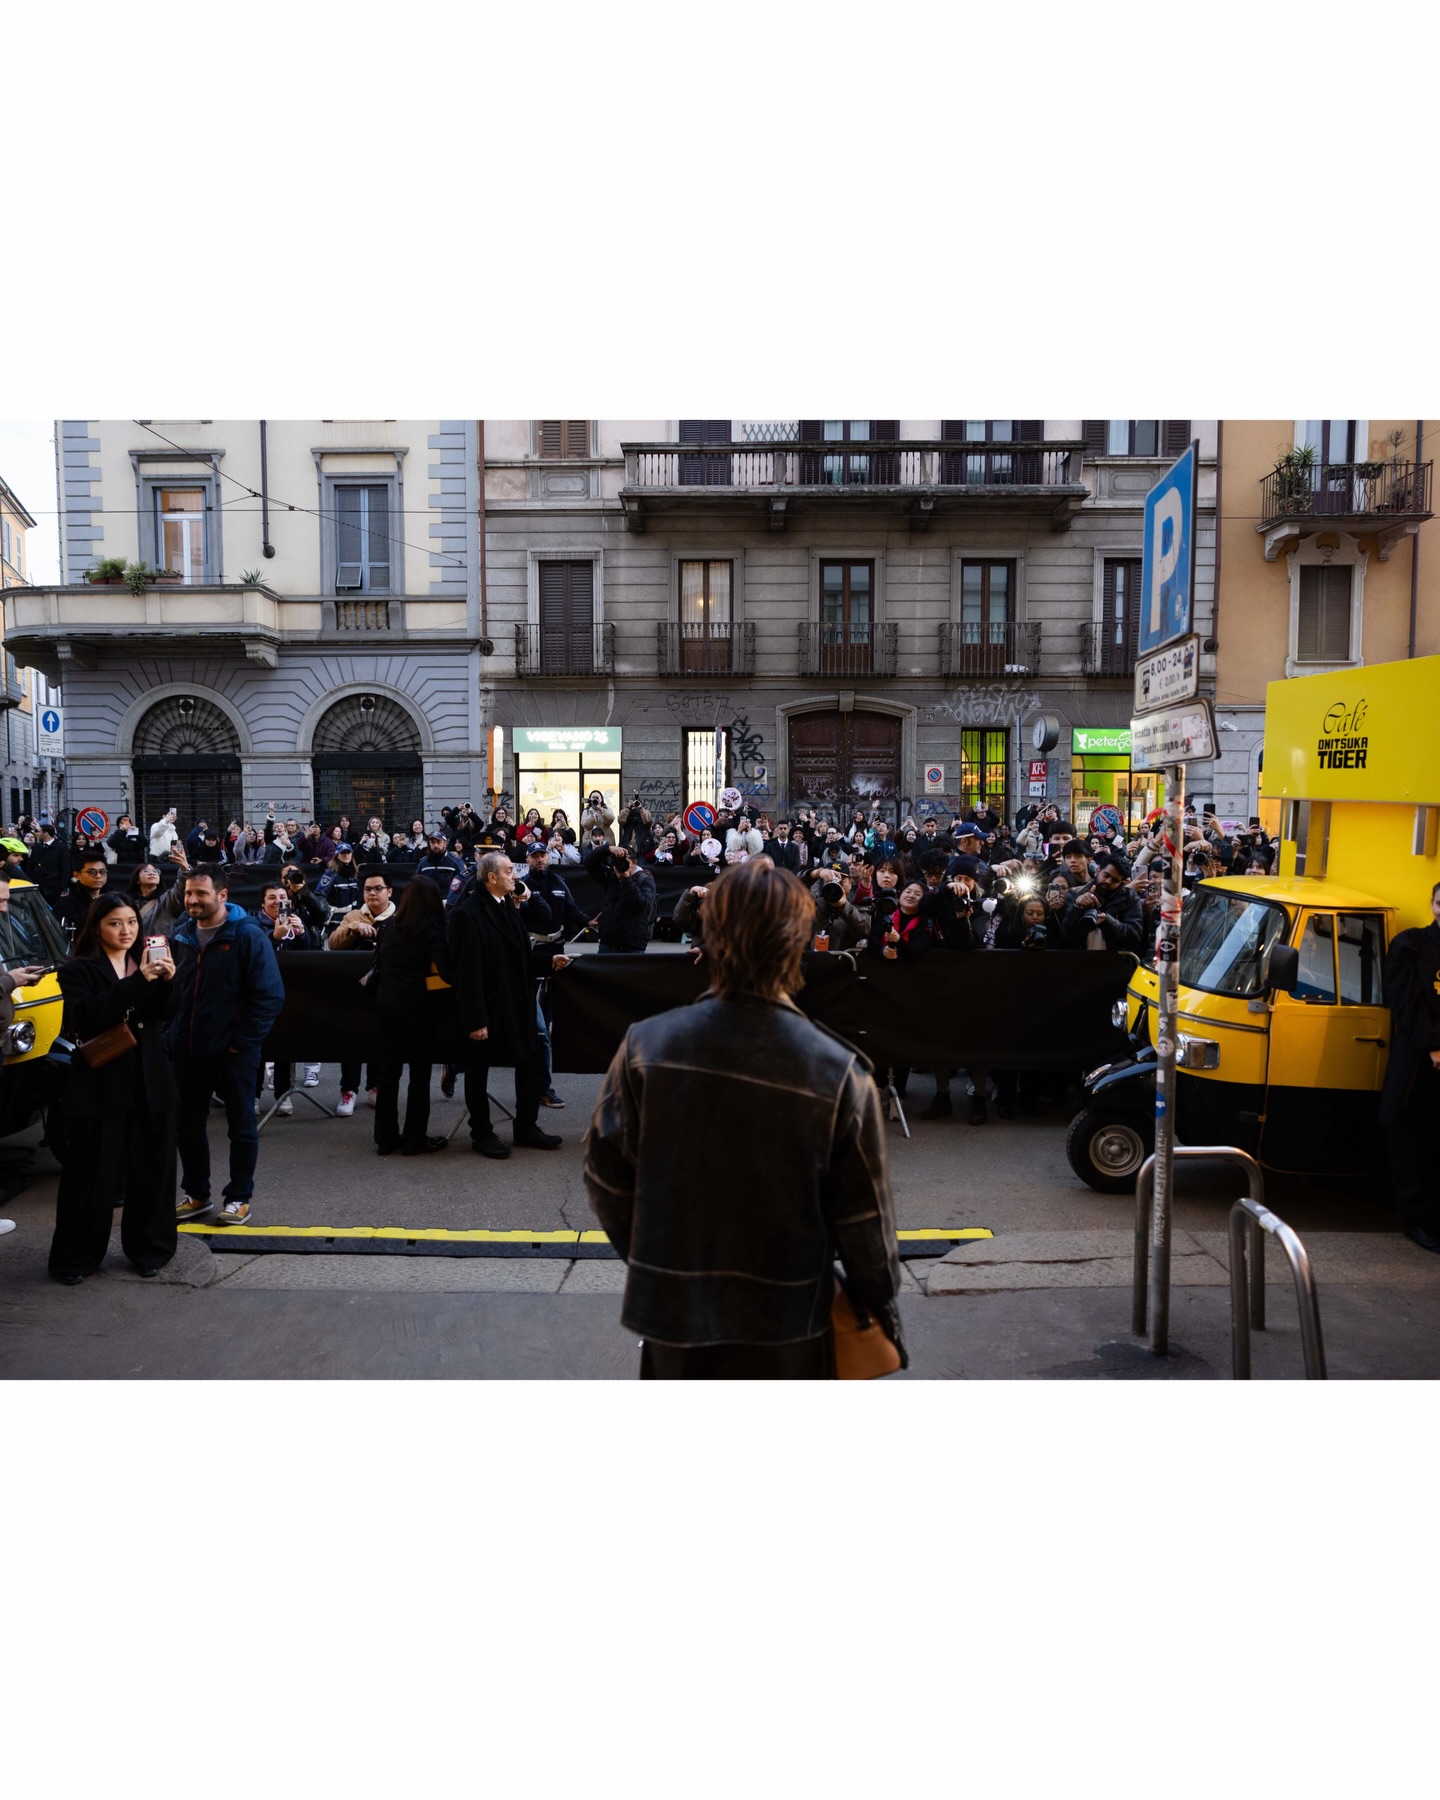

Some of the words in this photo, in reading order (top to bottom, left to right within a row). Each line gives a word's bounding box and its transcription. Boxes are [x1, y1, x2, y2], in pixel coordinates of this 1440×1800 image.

[1149, 486, 1183, 634] P
[1323, 699, 1368, 736] Café
[1318, 736, 1368, 750] ONITSUKA
[1031, 762, 1046, 775] KFC
[1317, 749, 1368, 769] TIGER
